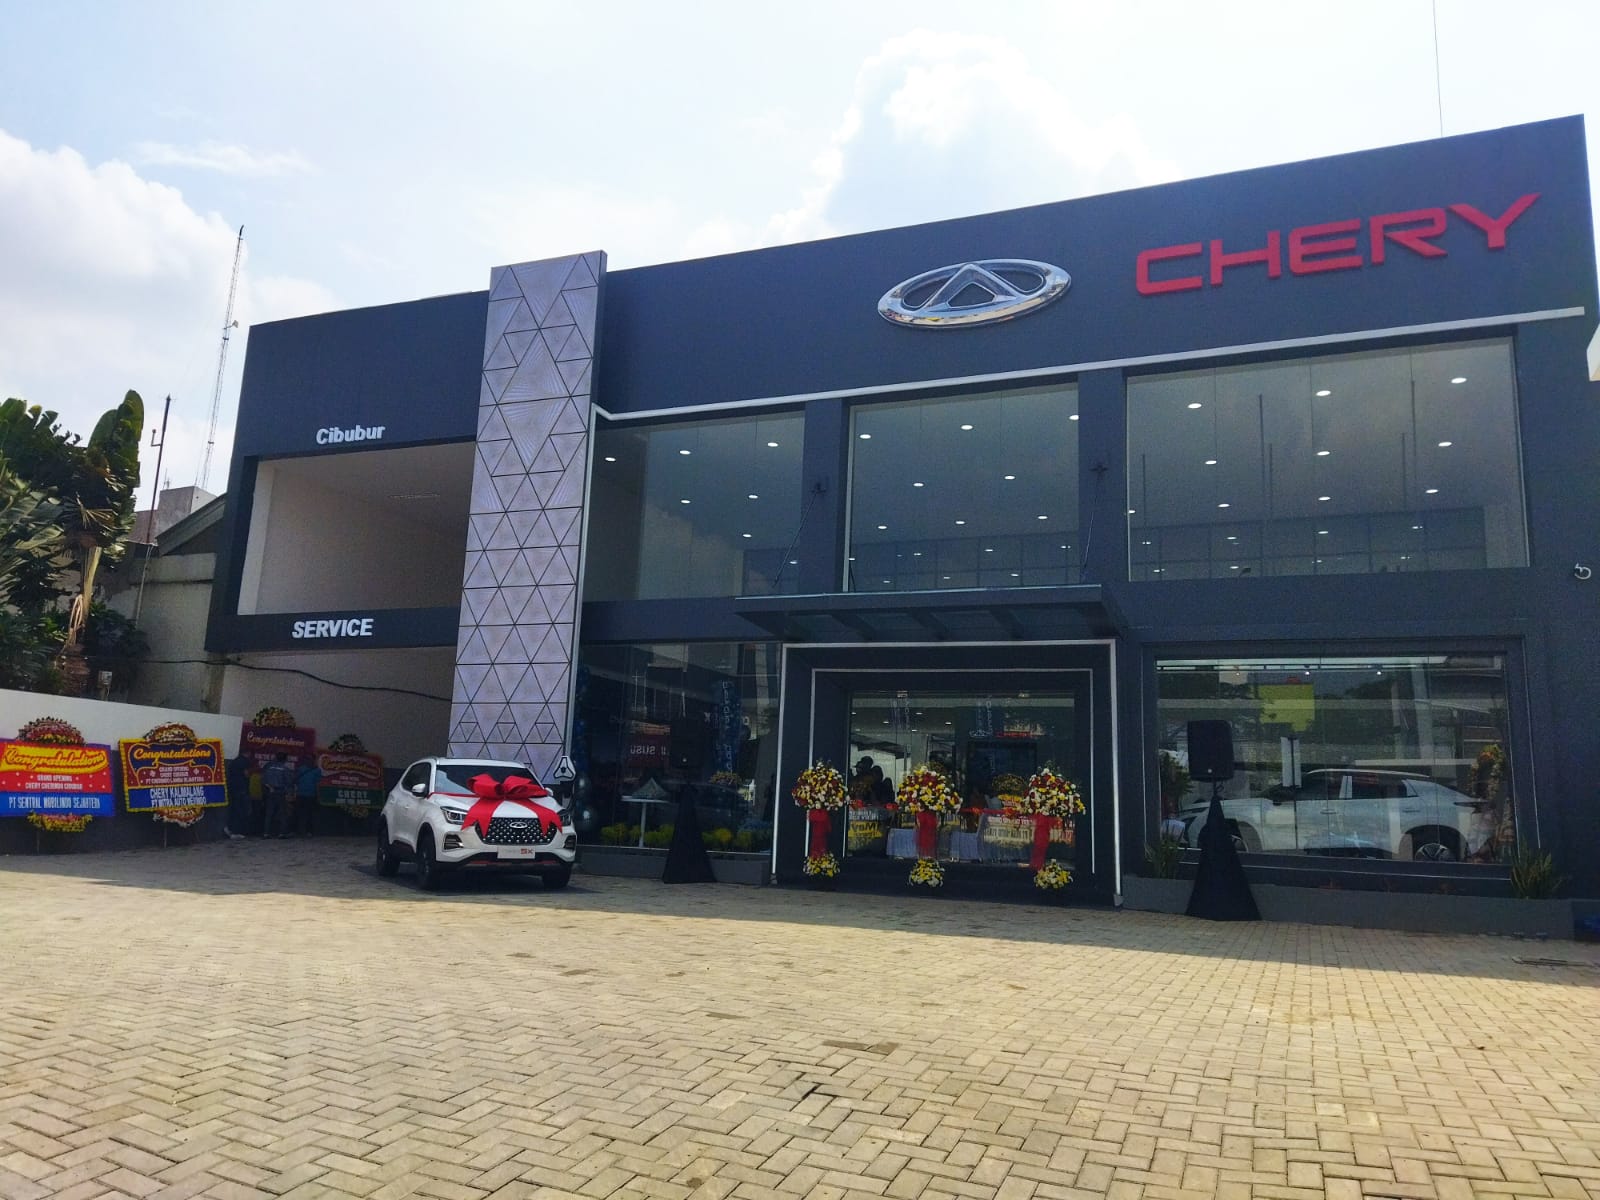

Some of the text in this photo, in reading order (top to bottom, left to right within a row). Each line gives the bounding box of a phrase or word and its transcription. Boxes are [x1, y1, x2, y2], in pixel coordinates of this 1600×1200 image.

[1136, 192, 1542, 296] CHERY
[316, 424, 386, 445] Cibubur
[292, 618, 374, 639] SERVICE
[5, 748, 106, 769] Congratulations
[133, 747, 211, 759] Congratulations
[8, 796, 16, 808] PT
